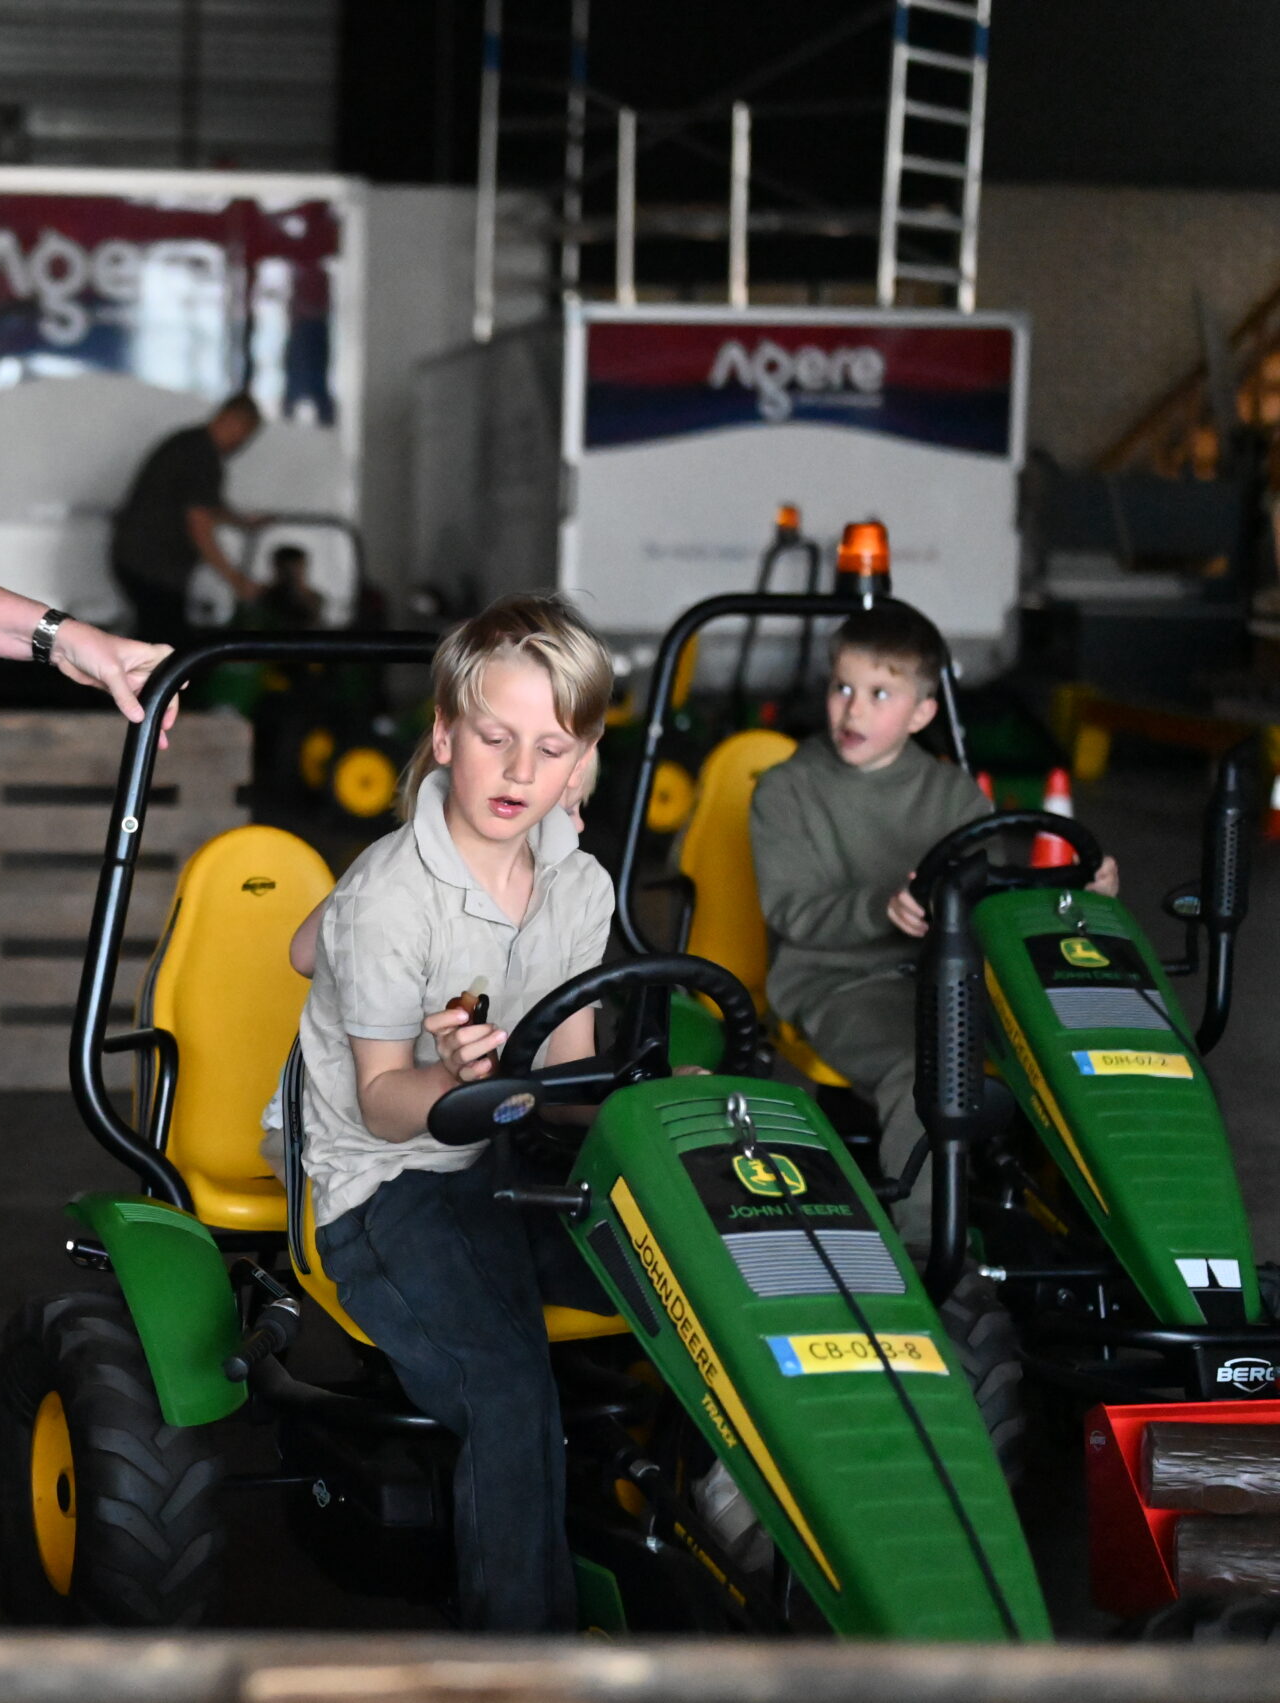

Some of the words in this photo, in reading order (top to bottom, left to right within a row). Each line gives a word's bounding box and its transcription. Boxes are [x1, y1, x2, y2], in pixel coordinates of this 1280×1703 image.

[709, 339, 885, 422] Agere
[728, 1204, 783, 1219] JOHN
[784, 1203, 853, 1216] EERE
[634, 1234, 673, 1304] JOHN
[669, 1296, 719, 1385] DEERE
